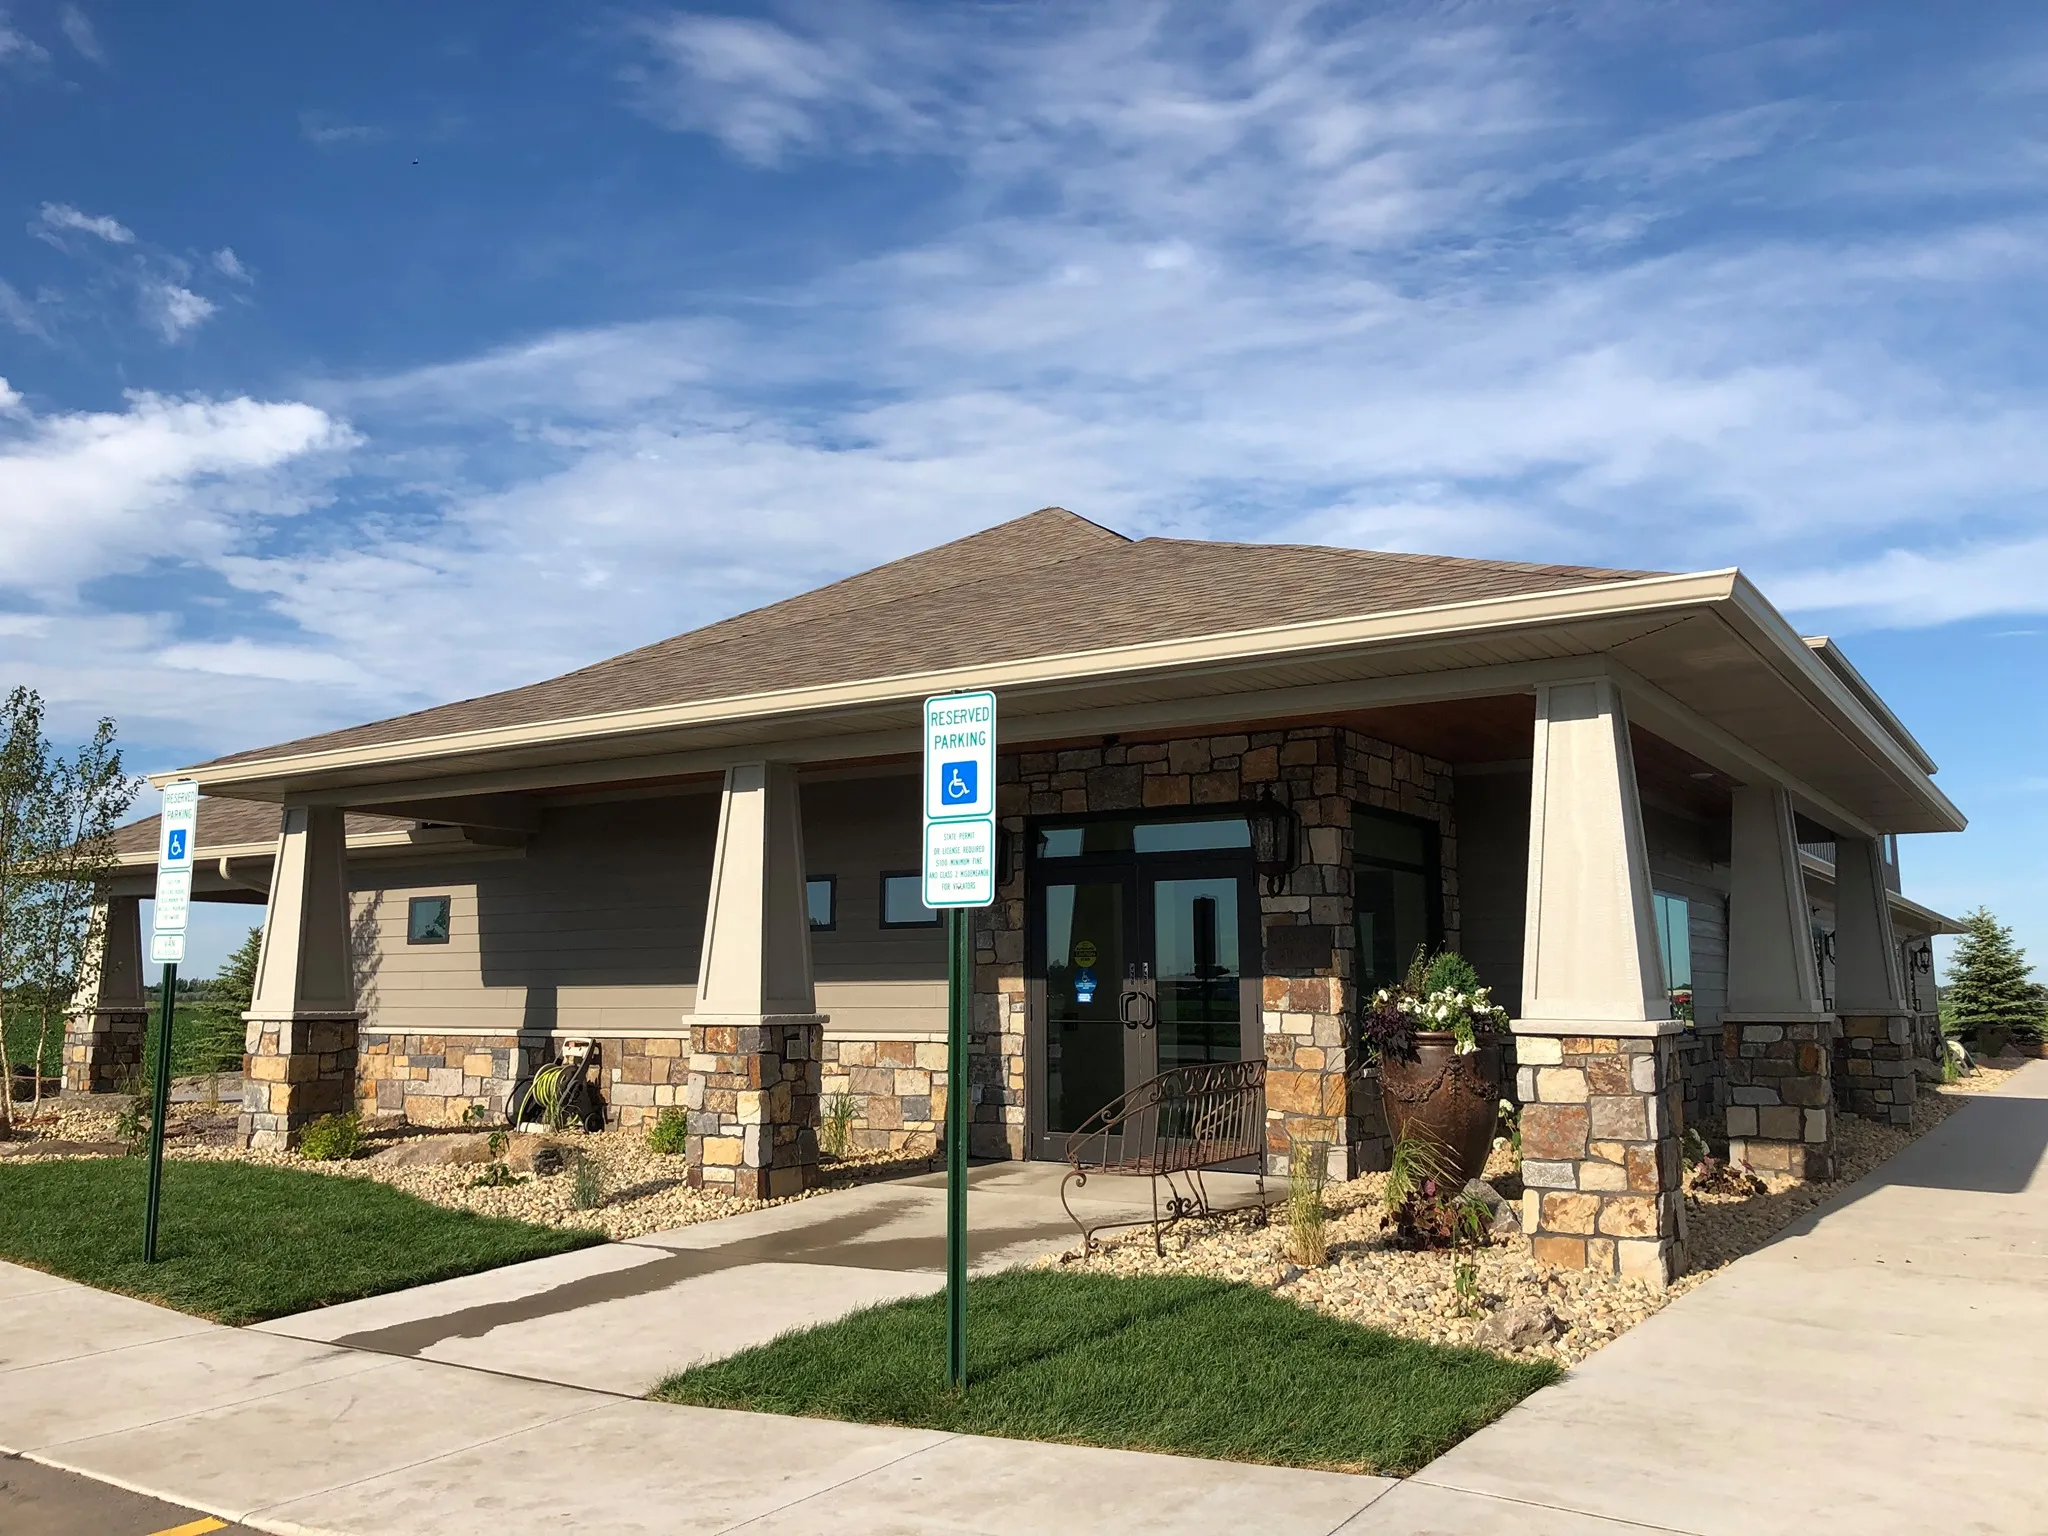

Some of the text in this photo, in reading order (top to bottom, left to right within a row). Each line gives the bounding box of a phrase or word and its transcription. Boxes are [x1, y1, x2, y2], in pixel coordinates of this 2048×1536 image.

[931, 706, 990, 727] RESERVED
[934, 730, 986, 750] PARKING
[166, 791, 195, 804] RESERVED
[167, 808, 193, 820] PARKING
[943, 831, 975, 841] STATE PERMIT
[933, 845, 985, 855] OR LICENSE REQUIRED
[972, 857, 982, 865] FINE
[929, 871, 938, 879] AND
[939, 870, 953, 879] CLASS
[941, 882, 950, 891] FOR
